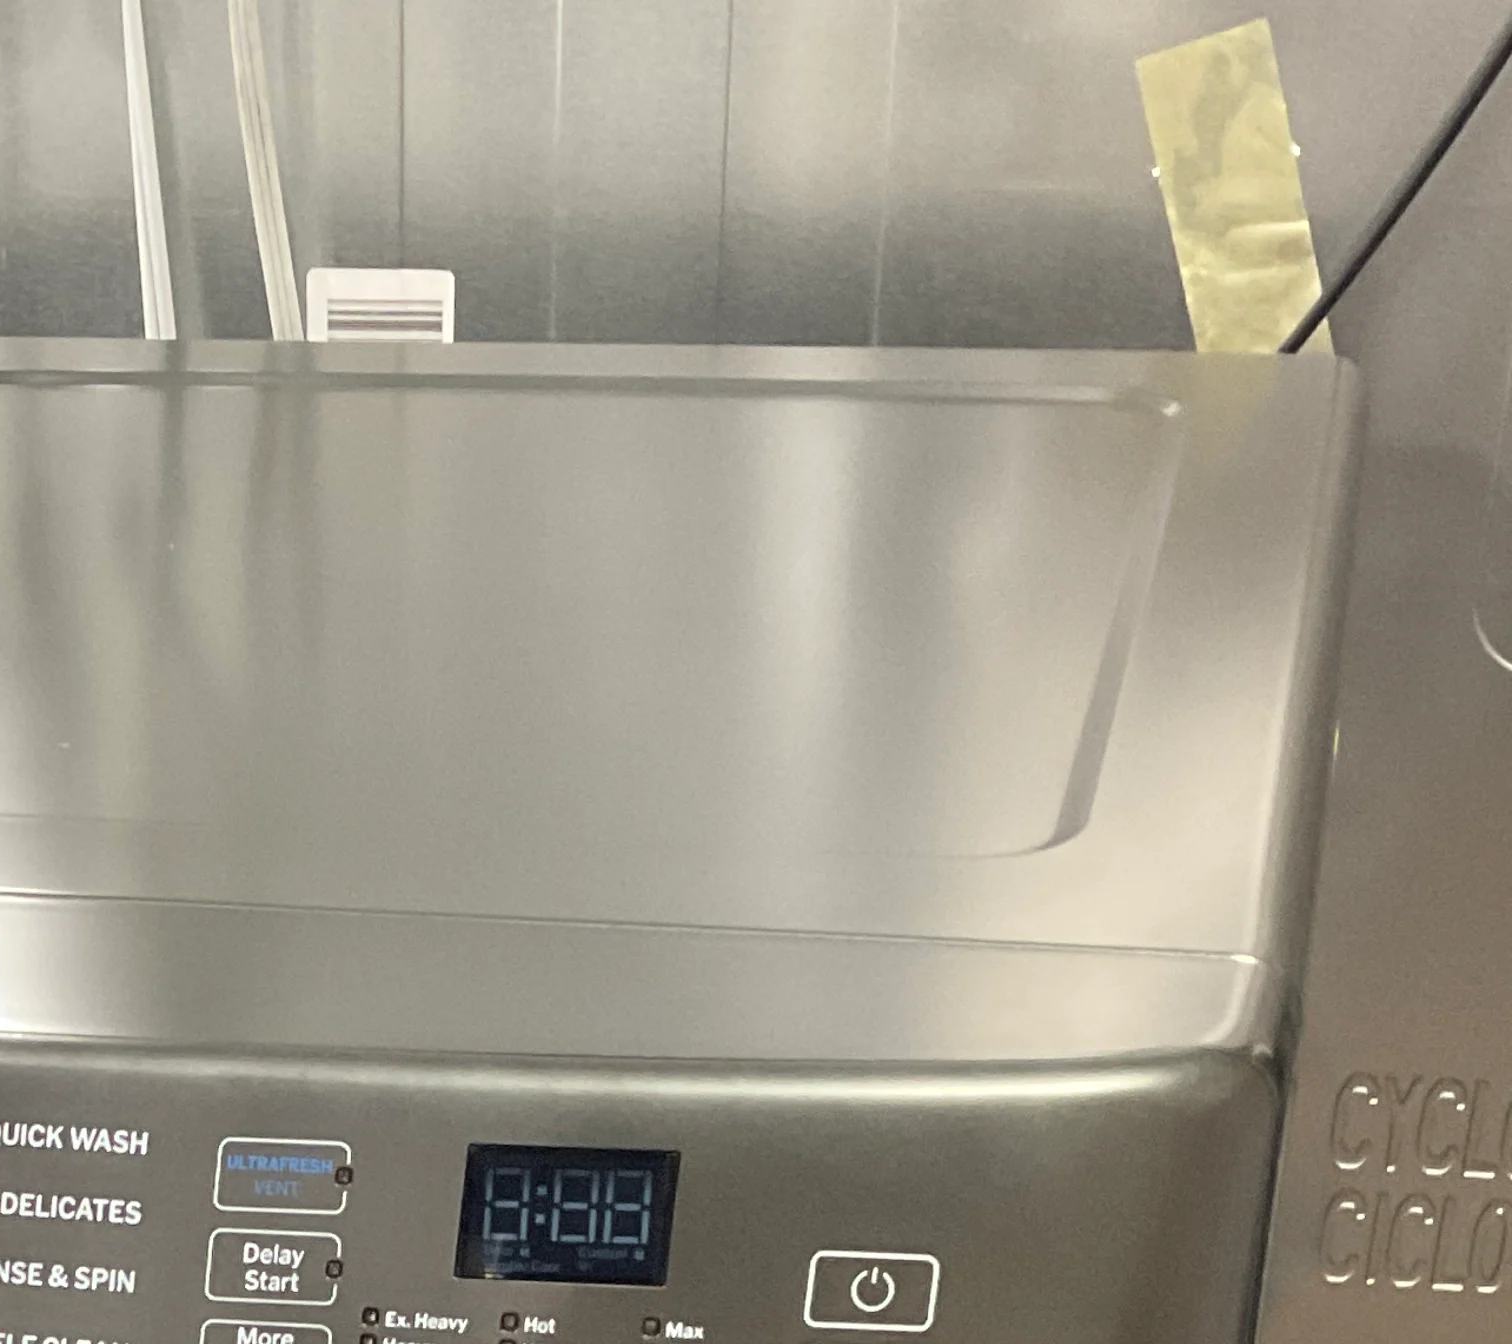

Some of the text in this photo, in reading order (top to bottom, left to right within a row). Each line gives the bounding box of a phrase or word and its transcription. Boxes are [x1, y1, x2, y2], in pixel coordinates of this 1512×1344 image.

[70, 1126, 149, 1156] WASH
[226, 1154, 333, 1174] ULTRAFRESH
[254, 1180, 301, 1197] VENT
[0, 1191, 143, 1226] DELICATES
[242, 1242, 305, 1269] Delay
[48, 1264, 69, 1289] &
[74, 1266, 136, 1294] SPIN
[244, 1269, 300, 1292] Start
[384, 1310, 469, 1334] Ex. Heavy
[524, 1316, 556, 1334] Hot
[665, 1321, 704, 1339] Max
